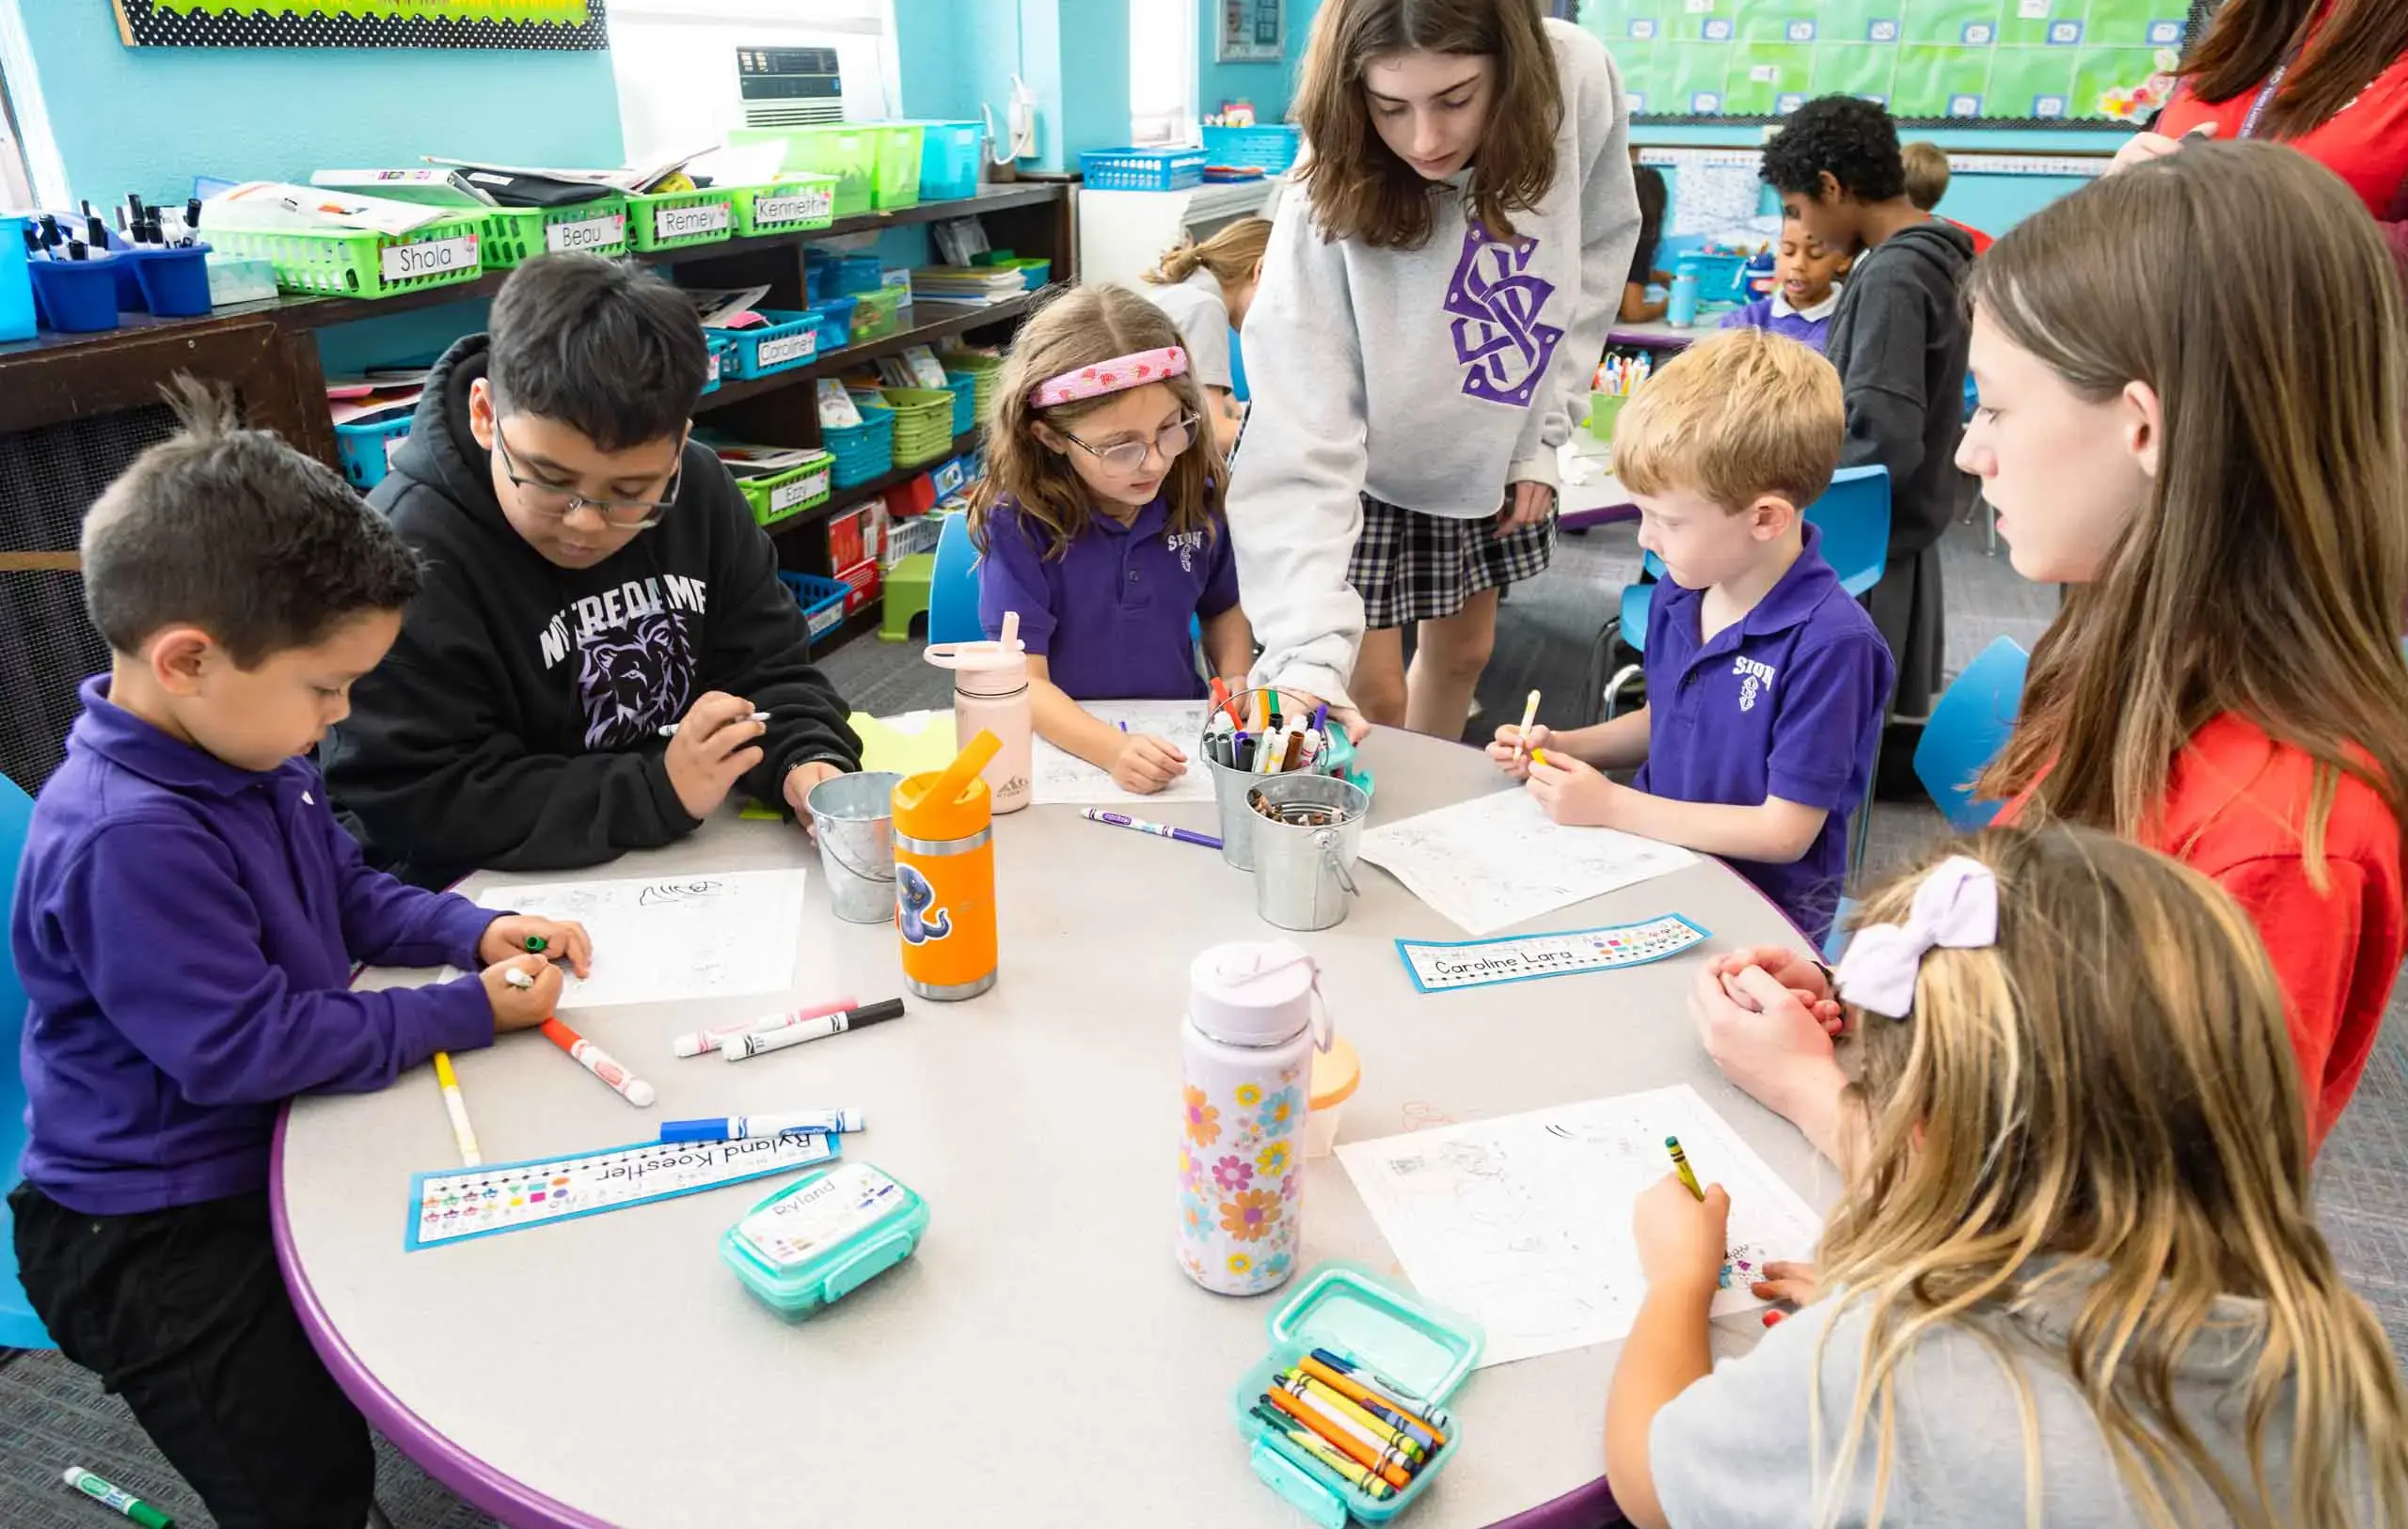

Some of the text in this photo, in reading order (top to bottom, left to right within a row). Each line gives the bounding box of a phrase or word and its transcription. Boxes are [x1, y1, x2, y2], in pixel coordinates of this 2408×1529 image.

[759, 197, 820, 218] Kenneth
[666, 213, 716, 231] Remey
[563, 226, 601, 246] Beau
[400, 244, 452, 273] Shola
[785, 486, 806, 503] Ezzy
[1168, 531, 1202, 551] SION
[1733, 655, 1775, 691] SION
[1434, 951, 1573, 975] Caroline Lara
[596, 1133, 811, 1181] Ryland Koestler
[772, 1178, 836, 1216] Ryland
